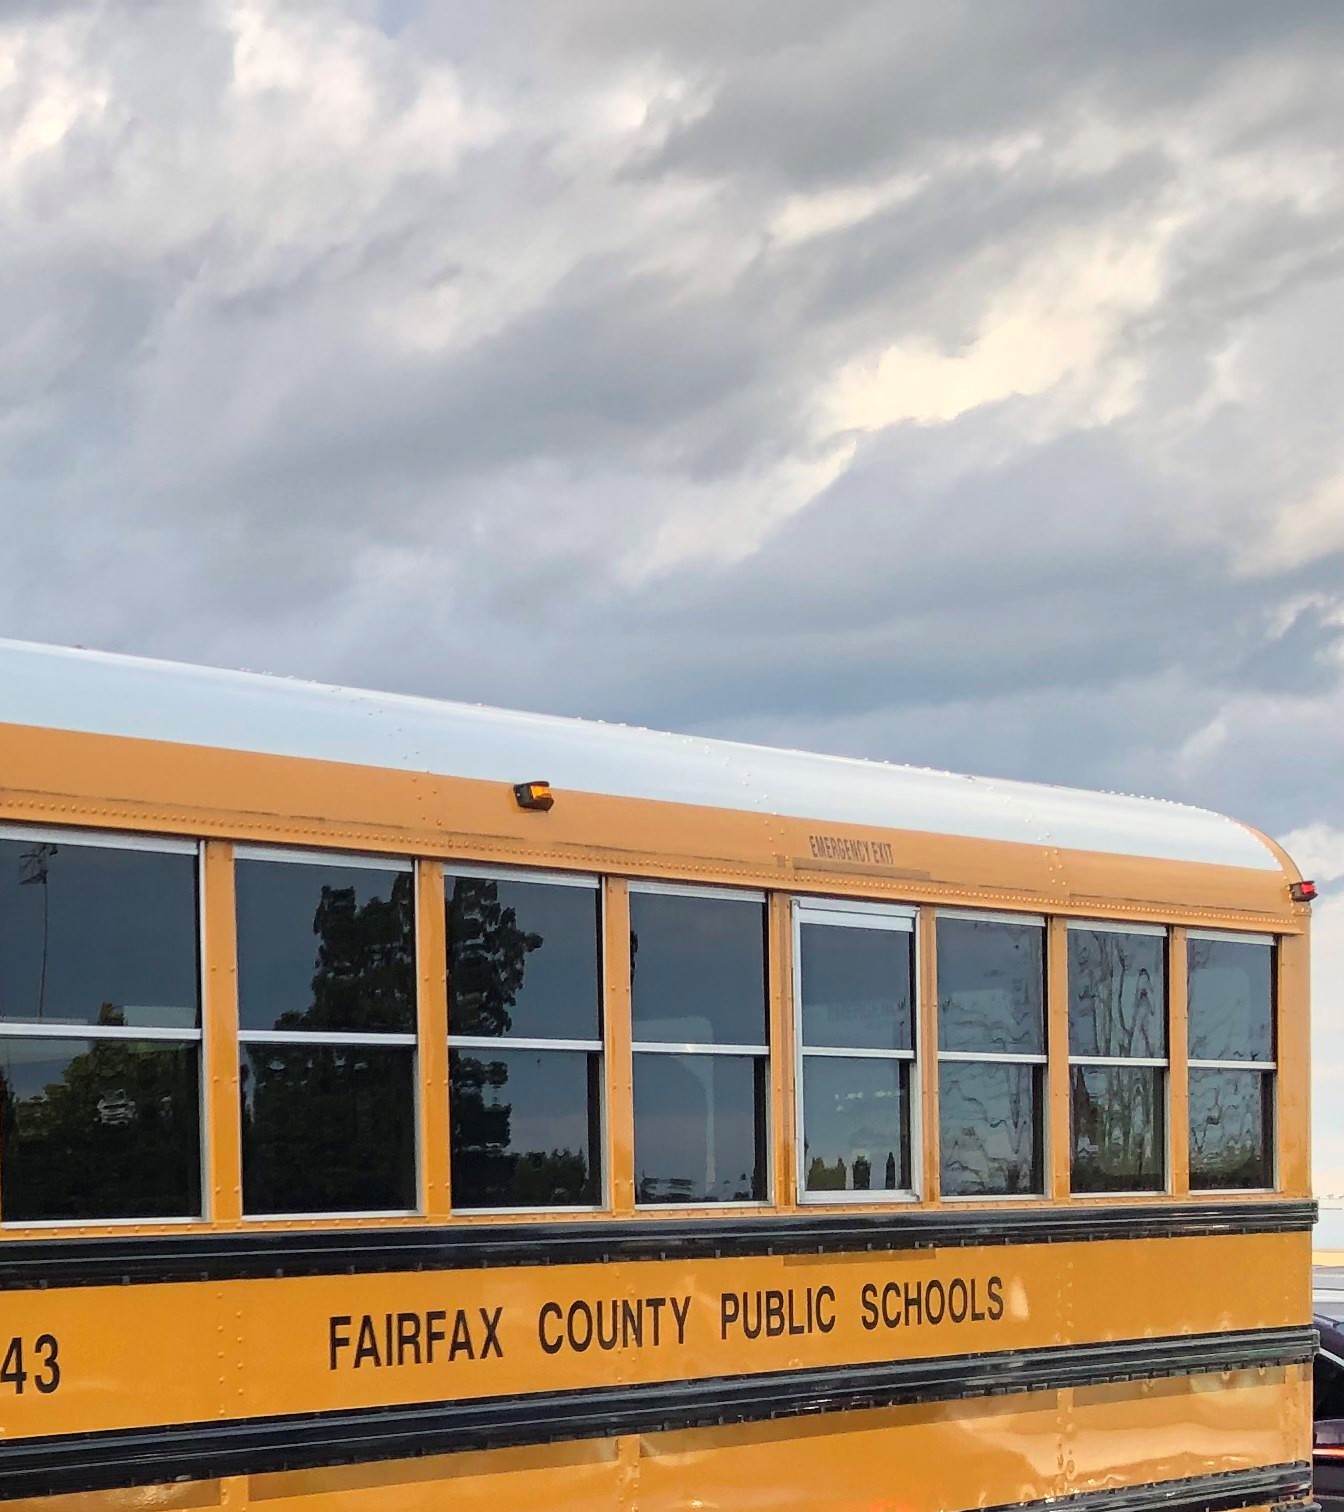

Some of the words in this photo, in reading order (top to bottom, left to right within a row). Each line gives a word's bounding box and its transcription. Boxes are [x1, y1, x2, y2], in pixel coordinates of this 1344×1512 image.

[809, 835, 870, 862] EMERGENCY
[871, 841, 893, 864] EXIT
[329, 1306, 504, 1371] FAIRFAX
[538, 1296, 692, 1355] COUNTY
[720, 1285, 836, 1341] PUBLIC
[861, 1276, 1004, 1331] SCHOOLS
